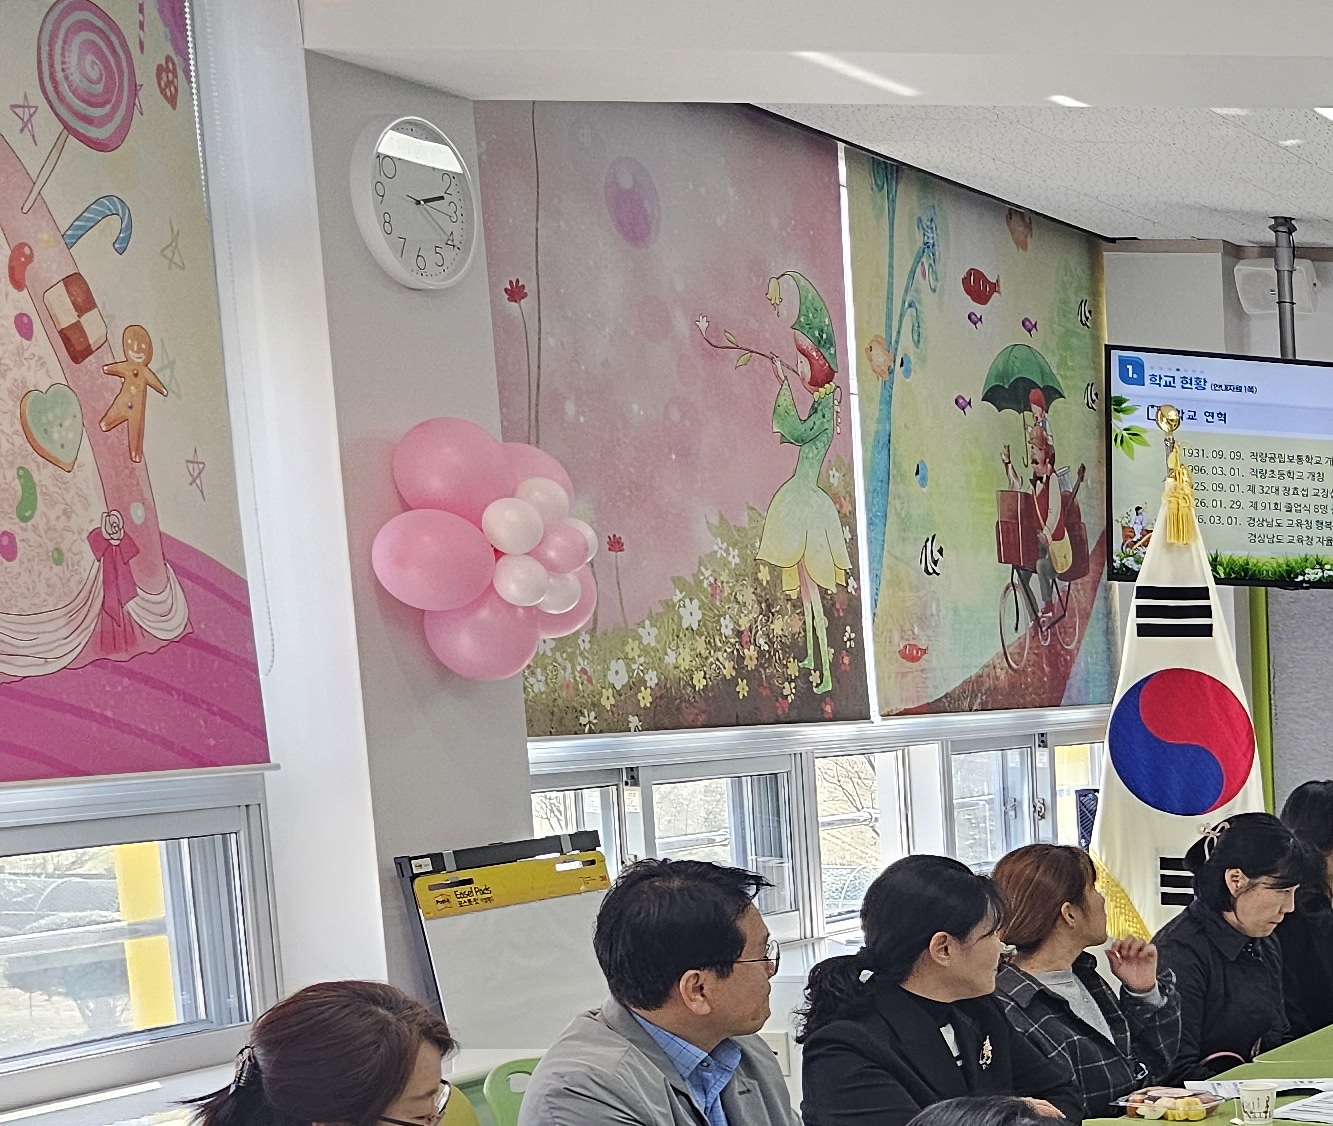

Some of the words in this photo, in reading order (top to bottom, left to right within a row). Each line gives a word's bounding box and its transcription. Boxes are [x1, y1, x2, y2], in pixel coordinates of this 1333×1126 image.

[376, 154, 397, 180] 10
[375, 182, 386, 205] 9
[442, 173, 453, 196] 2
[449, 201, 458, 224] 3
[383, 212, 392, 235] 8
[398, 237, 407, 258] 7
[445, 231, 456, 250] 4
[416, 247, 426, 270] 6
[435, 246, 445, 267] 5
[1126, 365, 1138, 379] 1.
[1149, 374, 1177, 389] 학교
[1180, 376, 1208, 391] 현황
[1204, 411, 1227, 424] 연혁
[1212, 450, 1226, 460] 09.
[1230, 451, 1245, 461] 09.
[1212, 466, 1226, 476] 03.
[1230, 468, 1245, 477] 01.
[1212, 483, 1226, 493] 09.
[1230, 484, 1245, 494] 01.
[1247, 484, 1256, 495] 제
[1259, 485, 1280, 496] 32대
[1212, 500, 1226, 509] 01.
[1230, 500, 1244, 510] 29.
[1249, 501, 1258, 511] 제
[1261, 501, 1282, 512] 91회
[1209, 516, 1224, 526] 03.
[1227, 516, 1242, 526] 01.
[1247, 517, 1284, 528] 경상남도
